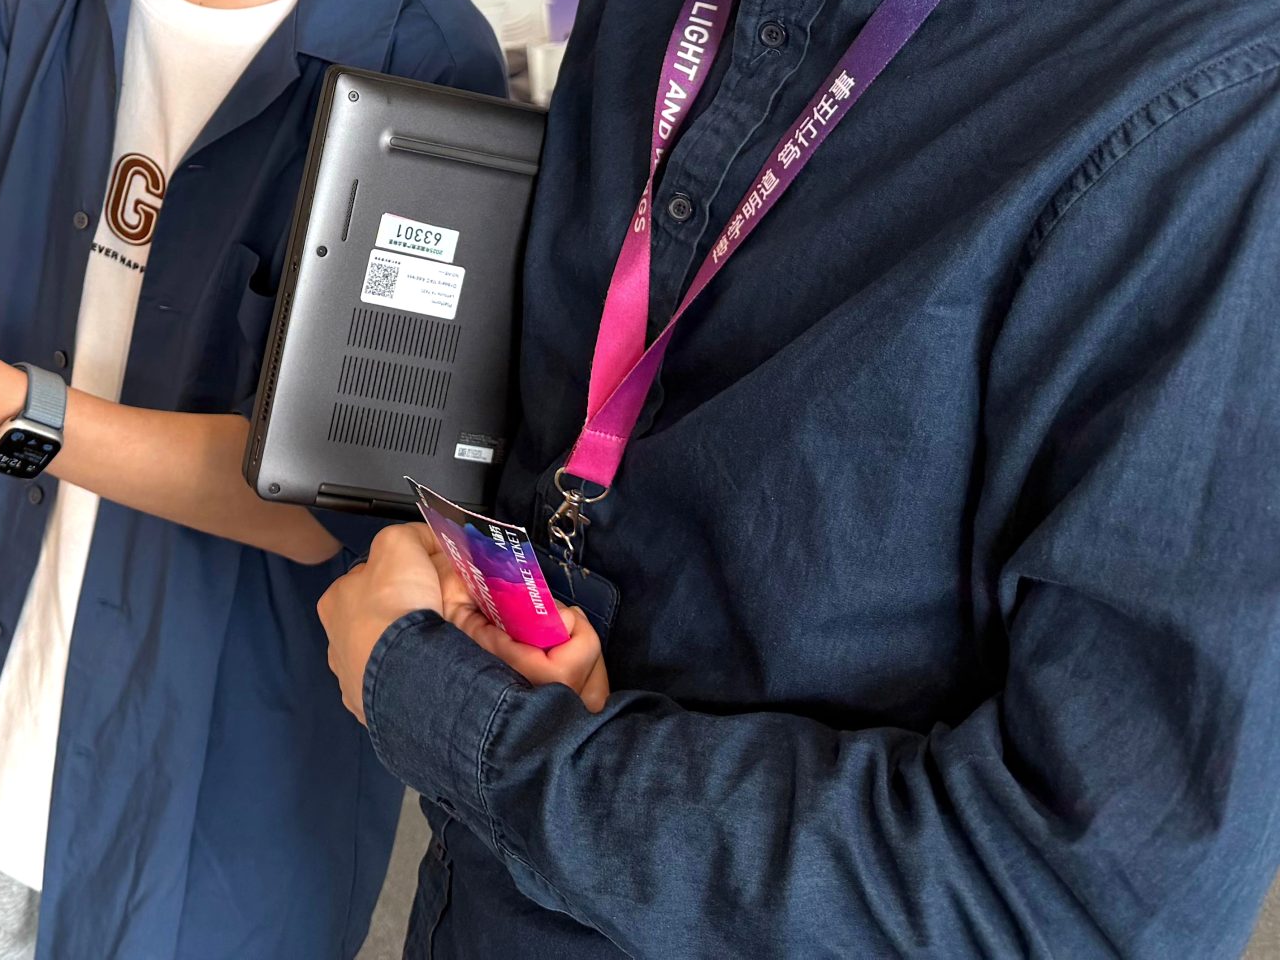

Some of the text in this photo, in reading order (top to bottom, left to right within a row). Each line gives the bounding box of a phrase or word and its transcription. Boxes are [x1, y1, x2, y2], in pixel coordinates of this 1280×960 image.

[673, 1, 718, 82] LIGHT
[658, 79, 687, 141] AND
[104, 152, 166, 246] G
[712, 70, 856, 264] 博学明道 笃行任事
[396, 224, 442, 246] 63301
[488, 524, 508, 551] 入场券
[505, 529, 548, 616] ENTRANCE TICKET
